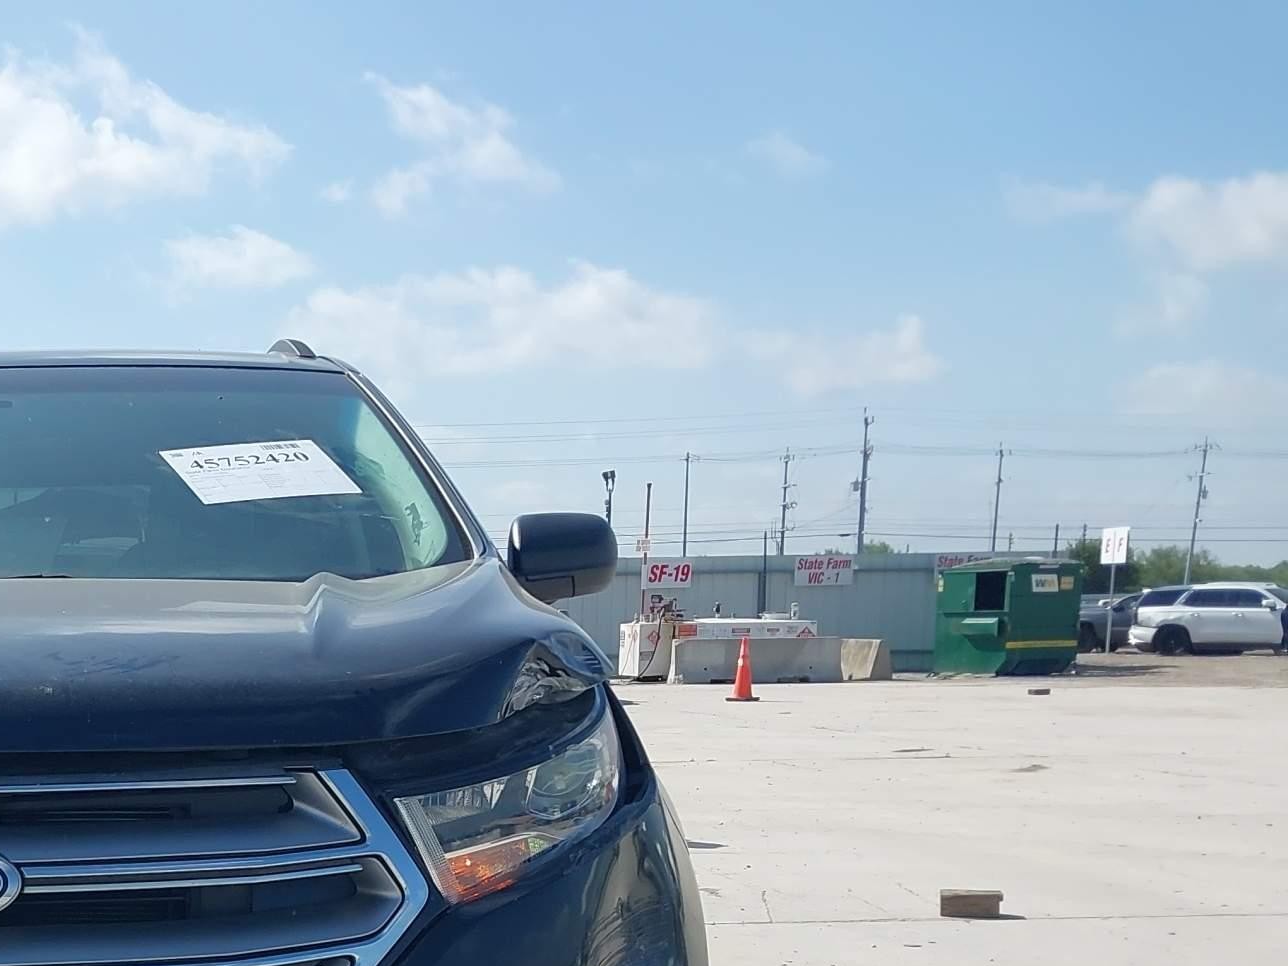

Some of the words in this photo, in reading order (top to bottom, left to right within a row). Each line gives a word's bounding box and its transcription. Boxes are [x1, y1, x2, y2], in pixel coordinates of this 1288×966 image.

[190, 451, 310, 470] 45752420
[797, 558, 824, 570] State
[826, 557, 852, 570] Farm
[648, 564, 691, 583] SF-19
[808, 572, 824, 584] VIC
